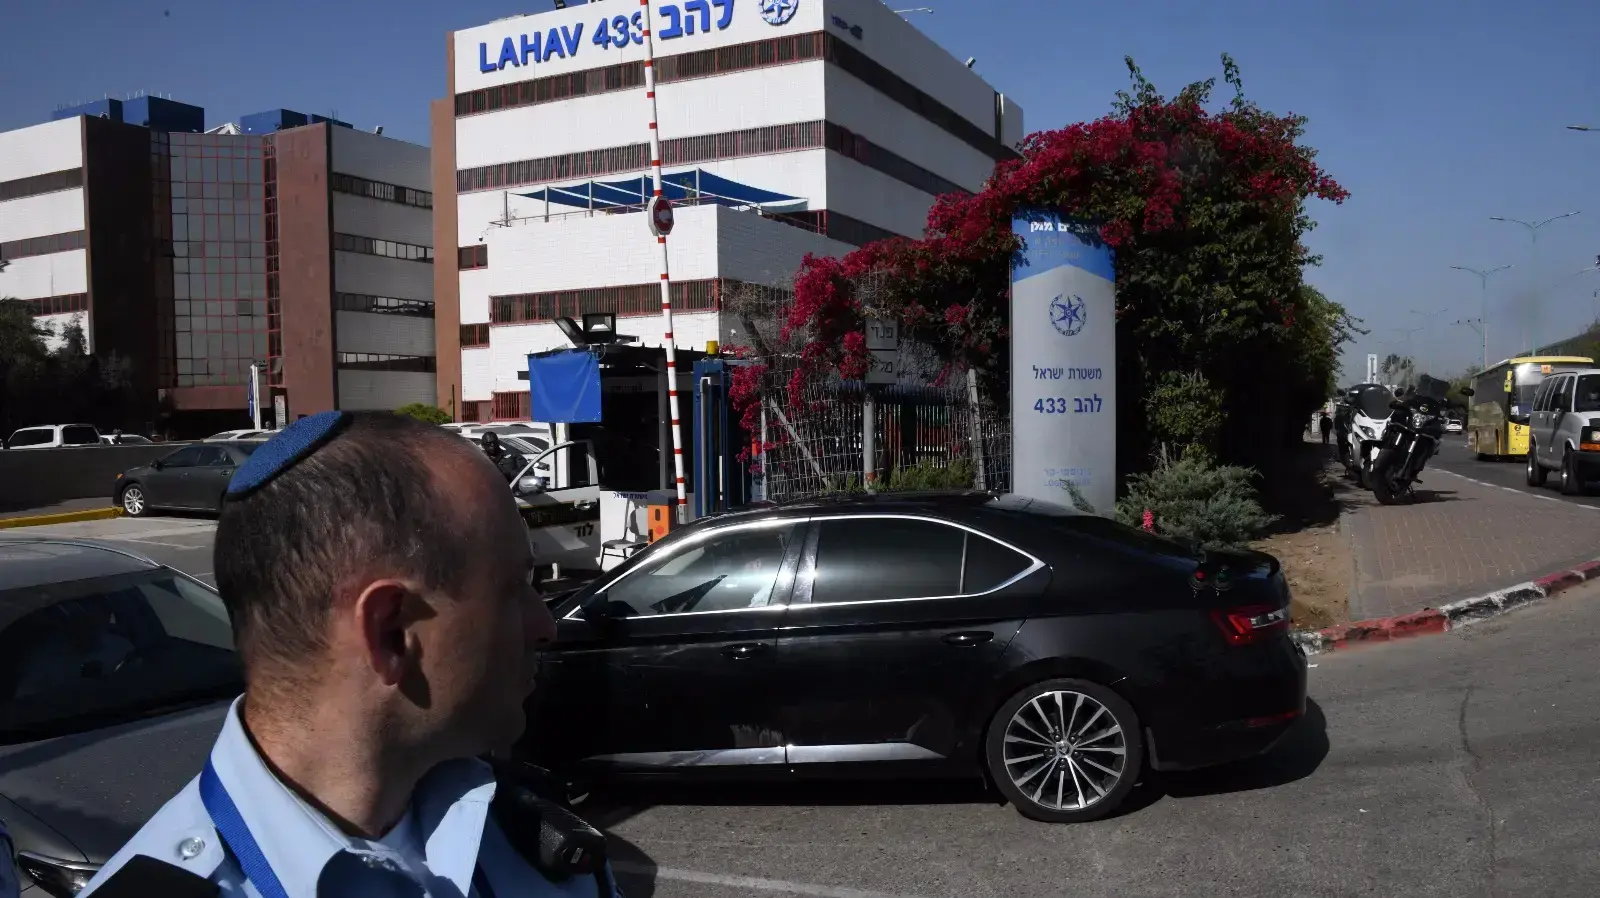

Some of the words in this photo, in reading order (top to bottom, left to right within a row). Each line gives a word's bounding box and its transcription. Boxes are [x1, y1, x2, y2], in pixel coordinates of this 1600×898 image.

[658, 0, 735, 41] להב
[479, 22, 584, 74] LAHAV
[592, 11, 644, 50] 433
[1032, 364, 1065, 380] ישראל
[1067, 367, 1102, 380] משטרת
[1033, 397, 1067, 414] 433
[1073, 393, 1102, 413] להב
[573, 522, 594, 538] לוד
